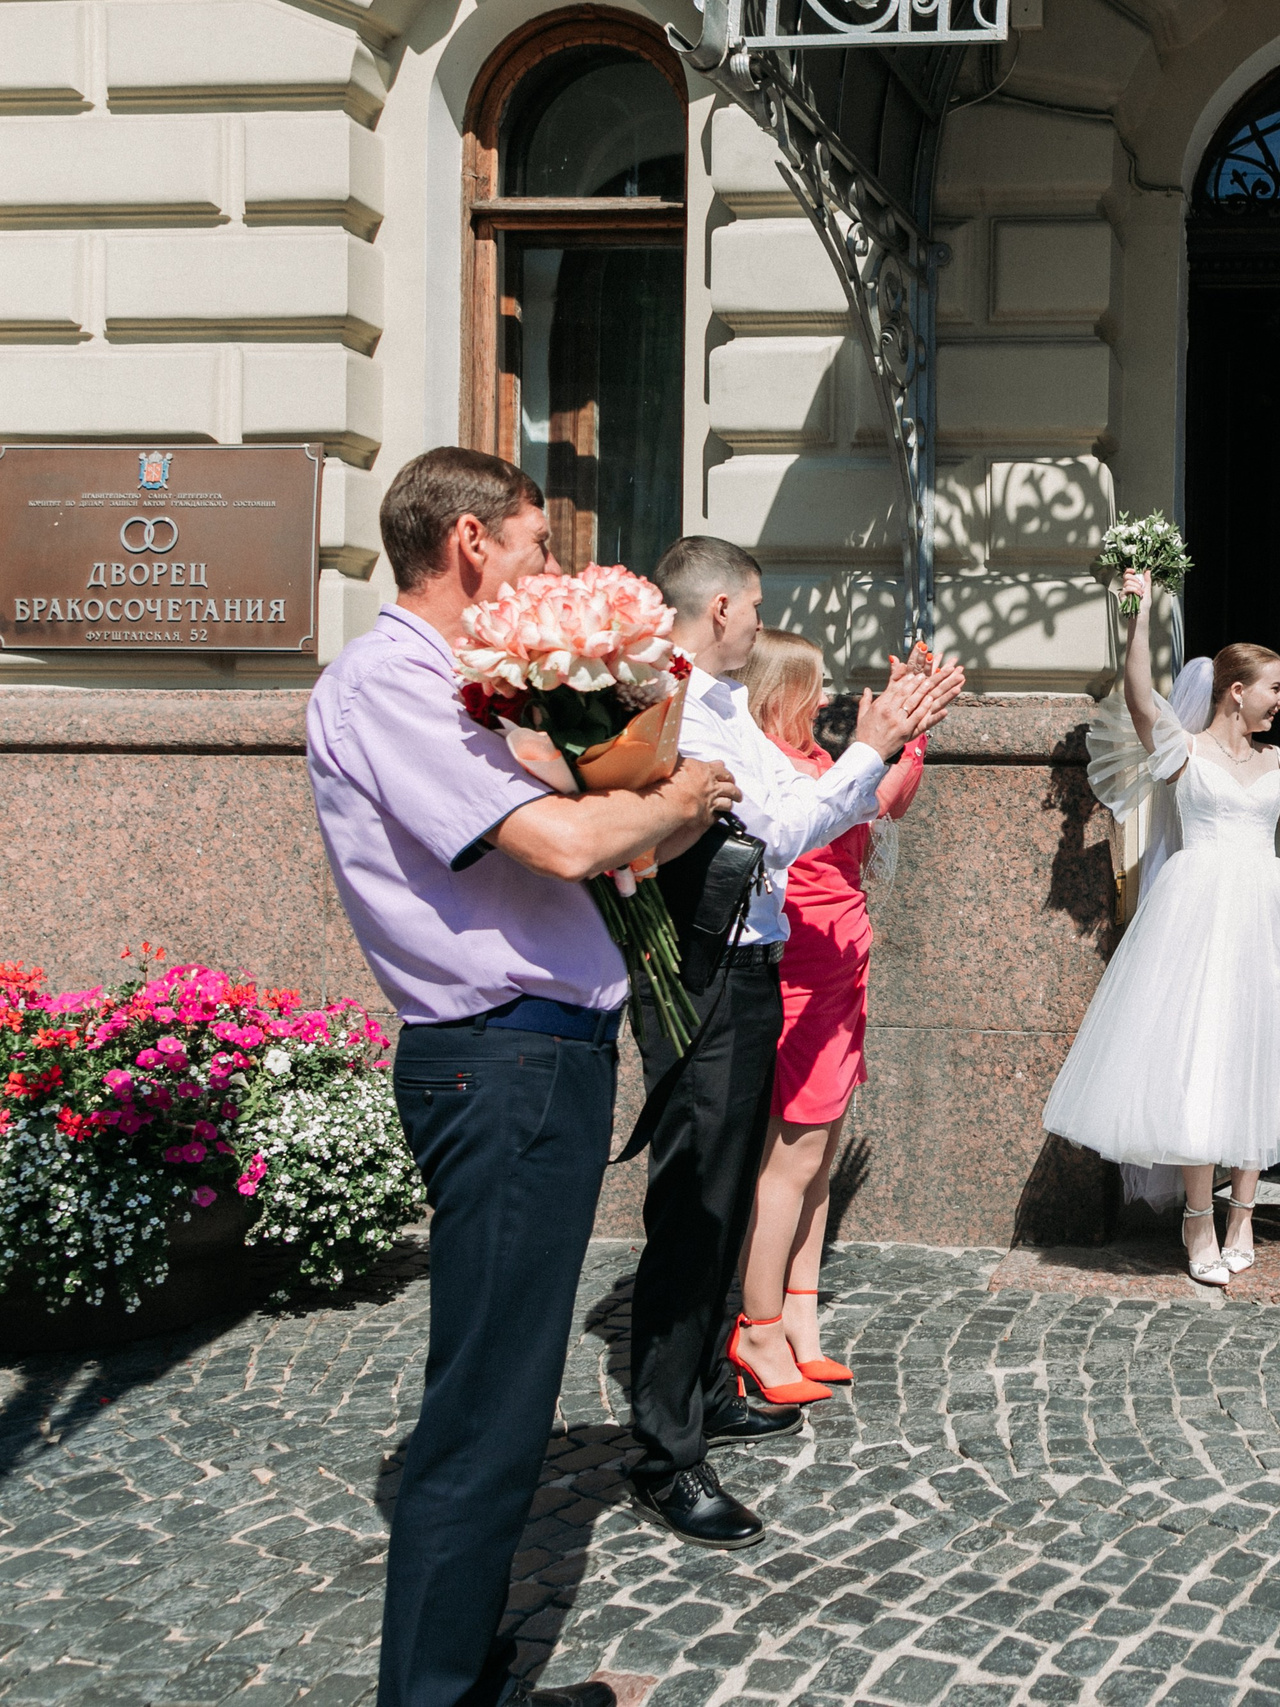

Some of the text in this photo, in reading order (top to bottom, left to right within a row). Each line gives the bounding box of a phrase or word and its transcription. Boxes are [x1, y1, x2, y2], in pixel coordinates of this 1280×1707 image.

[79, 500, 105, 508] ДЕЛАМ
[87, 562, 208, 589] ДВОРЕЦ
[14, 598, 287, 623] БРАКОСОЧЕТАНИЯ
[190, 628, 208, 642] 52
